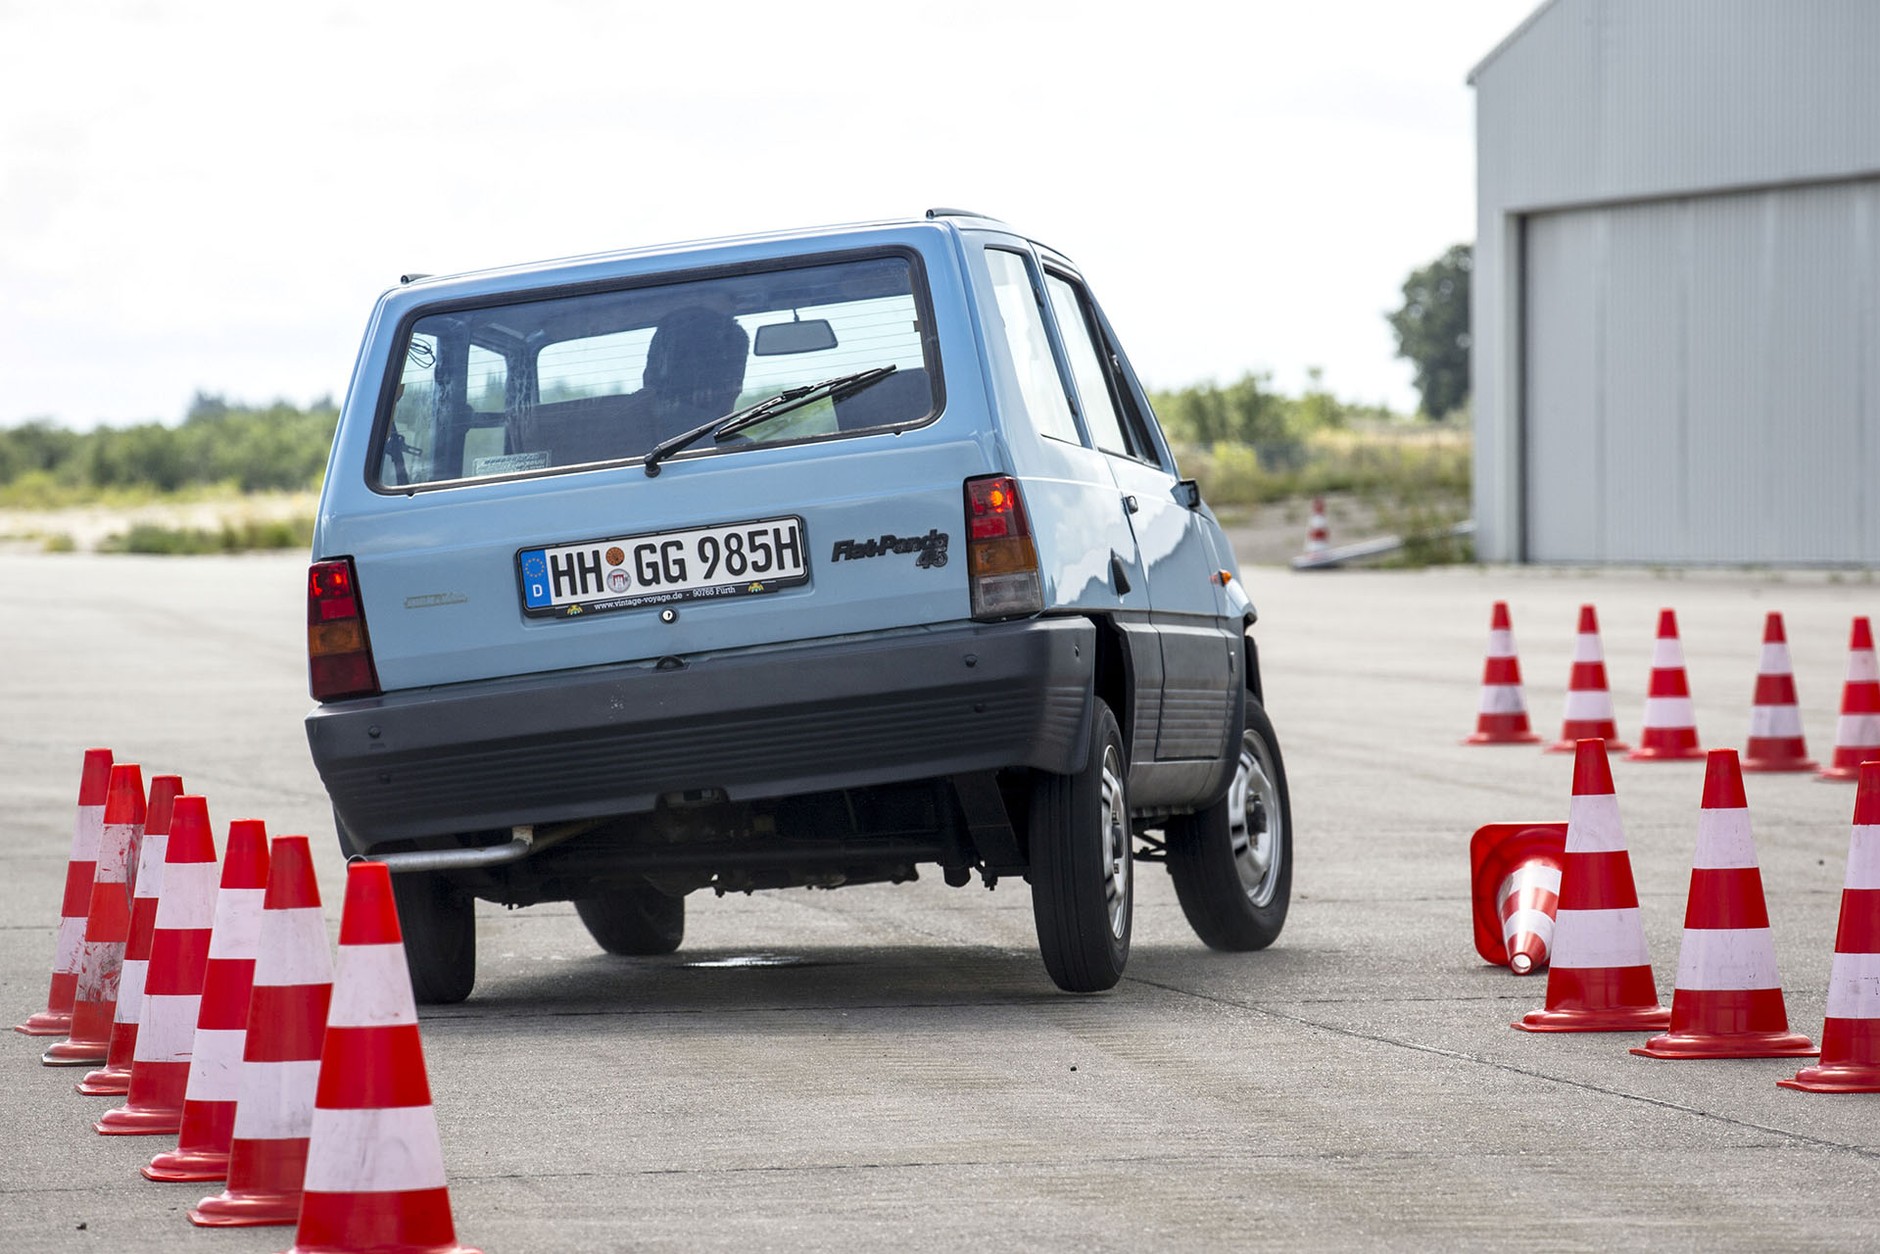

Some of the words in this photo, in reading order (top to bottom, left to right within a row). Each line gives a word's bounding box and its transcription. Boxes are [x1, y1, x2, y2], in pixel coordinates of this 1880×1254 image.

[550, 549, 604, 598] HH
[634, 540, 688, 587] GG
[697, 525, 801, 580] 985H
[915, 547, 948, 569] 45
[532, 584, 543, 597] D
[594, 591, 683, 611] www.vintage-voyage.de
